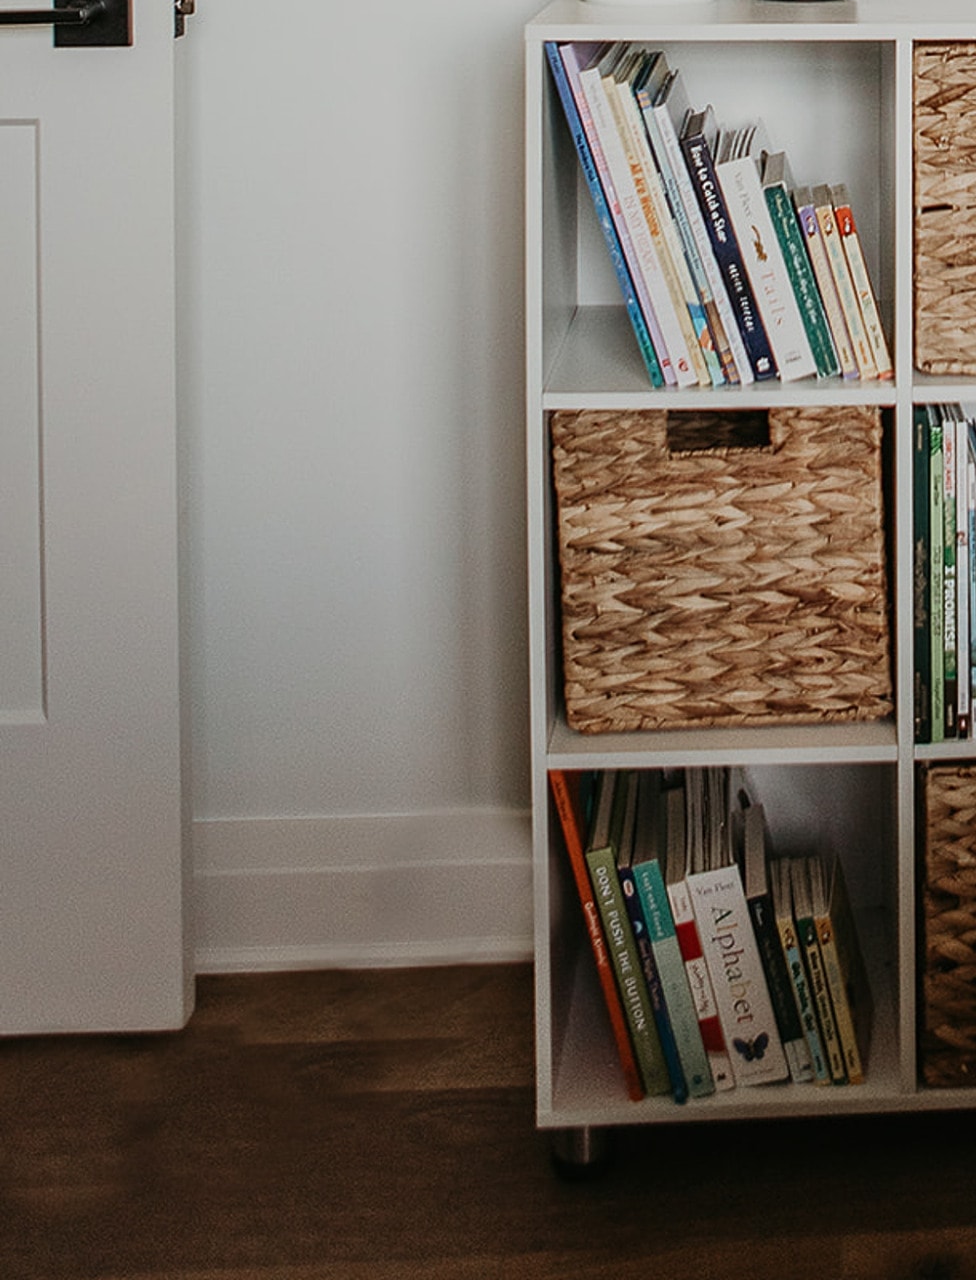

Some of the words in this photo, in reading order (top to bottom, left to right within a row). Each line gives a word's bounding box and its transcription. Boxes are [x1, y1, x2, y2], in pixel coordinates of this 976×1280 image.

[628, 160, 642, 175] All
[689, 144, 706, 167] How
[633, 175, 648, 194] Are
[696, 166, 710, 181] to
[622, 194, 637, 209] IN
[700, 180, 720, 211] Catch
[626, 208, 643, 230] MY
[639, 194, 662, 238] Welcome
[710, 210, 720, 219] a
[712, 217, 730, 244] Star
[634, 230, 657, 273] HEART
[759, 269, 789, 327] Tails
[944, 565, 954, 577] I
[943, 579, 955, 650] PROMISE
[594, 864, 617, 906] DON'T
[606, 908, 626, 946] PUSH
[616, 949, 633, 974] THE
[704, 901, 761, 1026] Alphabet
